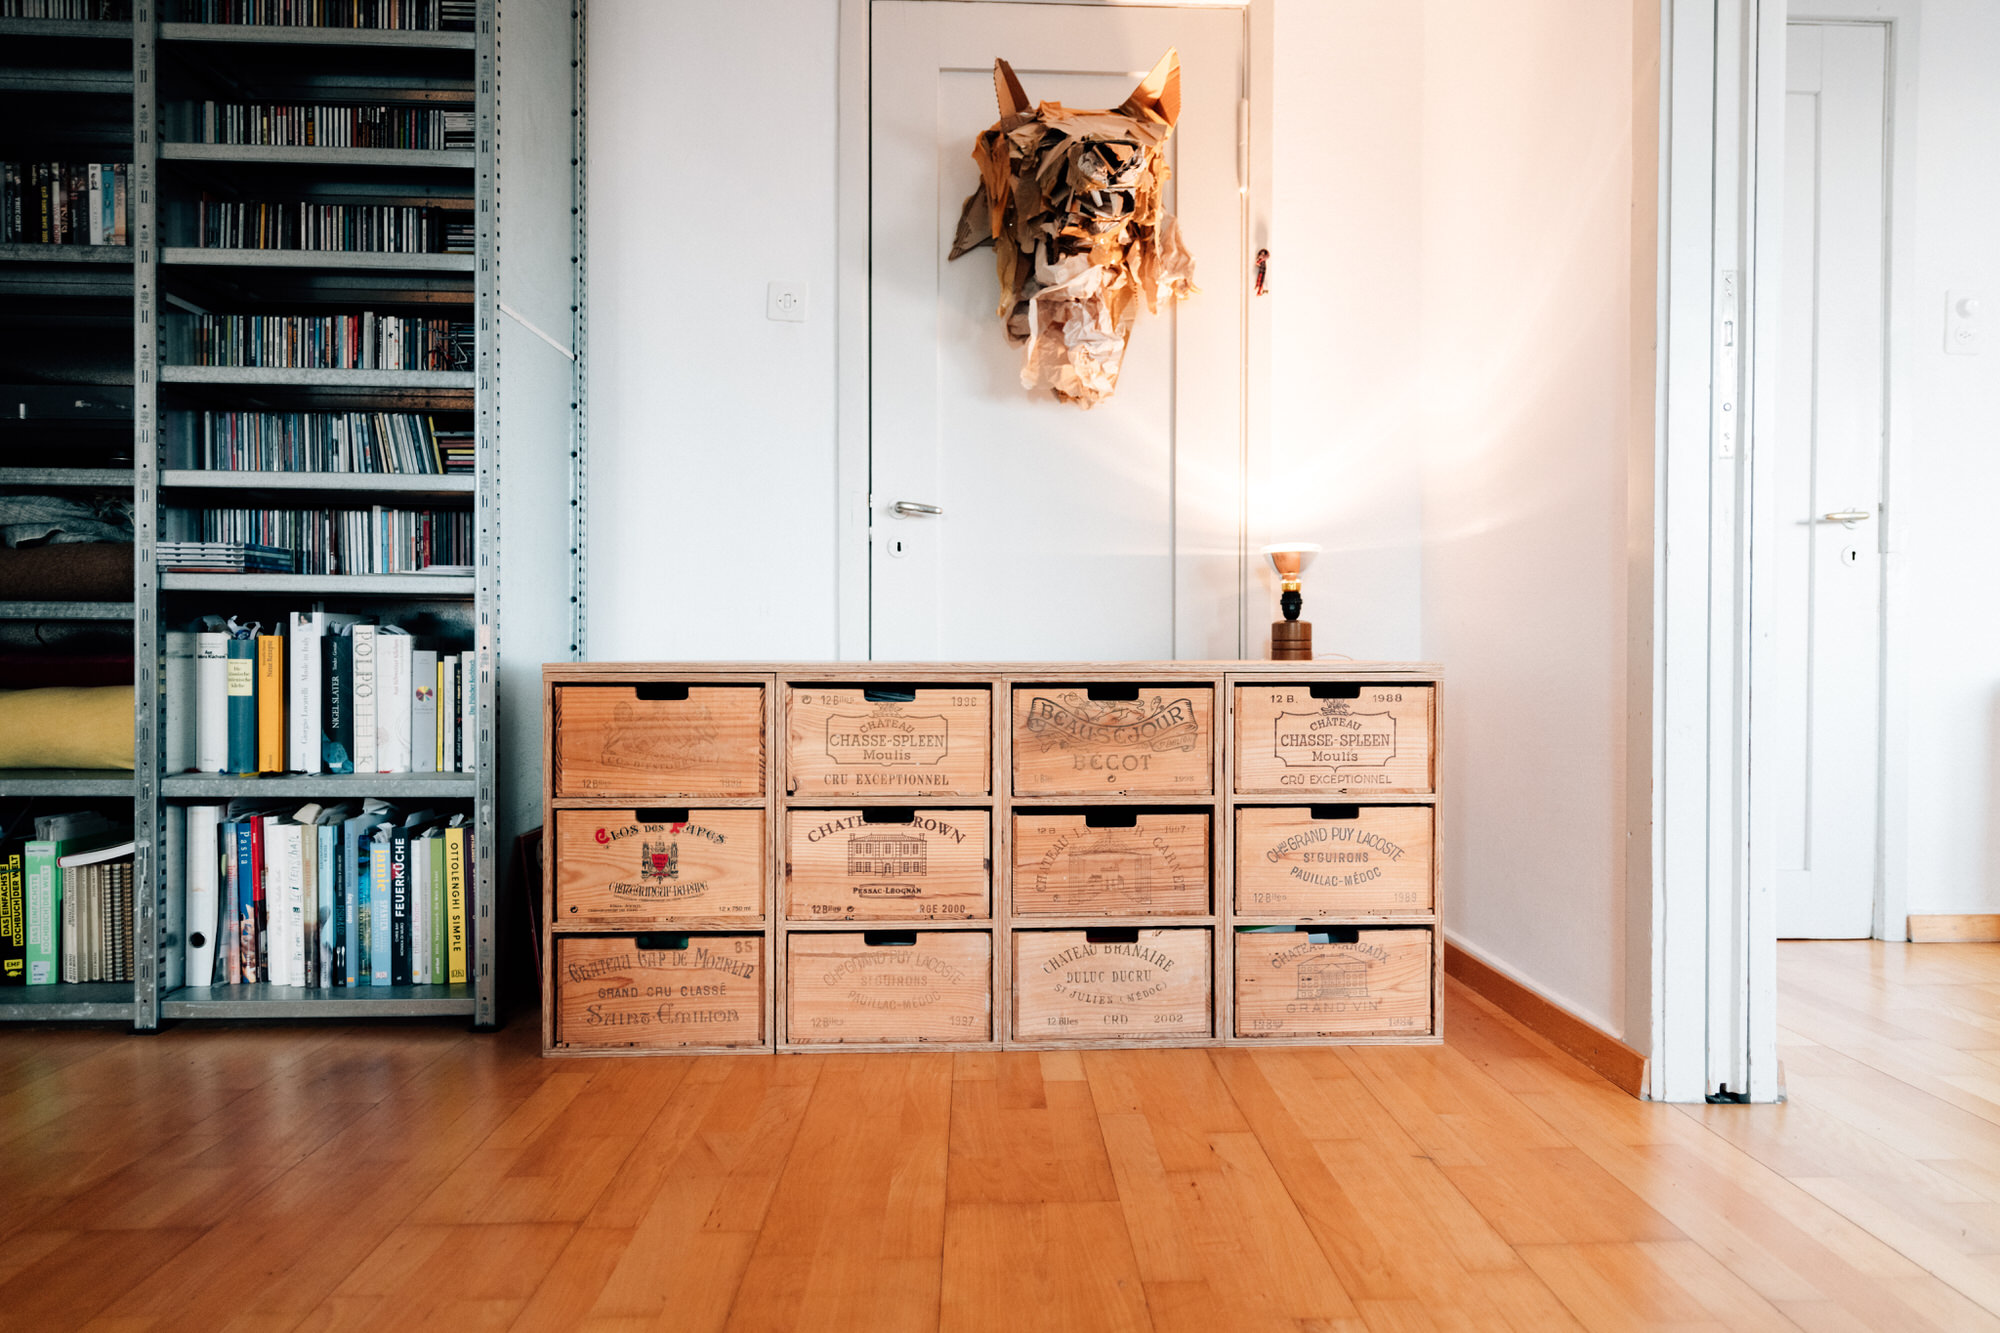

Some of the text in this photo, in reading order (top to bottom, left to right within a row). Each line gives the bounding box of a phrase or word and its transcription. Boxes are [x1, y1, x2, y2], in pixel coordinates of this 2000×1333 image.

[355, 631, 373, 699] POLPO
[331, 675, 340, 704] SLATER
[1373, 693, 1403, 703] 1988
[331, 705, 340, 729] NIGEL
[829, 734, 944, 747] CHASSE-SPLEEN
[863, 750, 911, 760] Moulis
[1312, 751, 1359, 762] Moulis
[824, 774, 949, 785] CRU EXCEPTIONNEL
[1310, 774, 1392, 785] EXCEPTIONNEL
[902, 815, 966, 844] ROWN
[240, 831, 250, 864] Pasta
[1287, 827, 1328, 850] GRAND
[1331, 827, 1354, 841] PUY
[1356, 829, 1405, 862] LACOSTE
[1317, 852, 1369, 863] GUIRONS
[374, 850, 390, 892] jamie
[393, 838, 405, 917] FEUERKÜCHE
[0, 865, 11, 935] DAS EINFACHSTE
[10, 856, 22, 945] KOCHBUCH DER WELT
[31, 876, 39, 942] DAS EINFACHSTE
[451, 842, 461, 952] OTTOLENGHI SIMPLE
[919, 904, 966, 914] RGE 2000
[41, 867, 50, 953] KOCHBUCH DER WELT
[1067, 970, 1153, 983] DULUC DUCRU
[598, 982, 727, 998] GRAND CRU CLASSÉ
[1286, 1001, 1378, 1013] GRAND VIN
[1103, 1015, 1129, 1025] CRD
